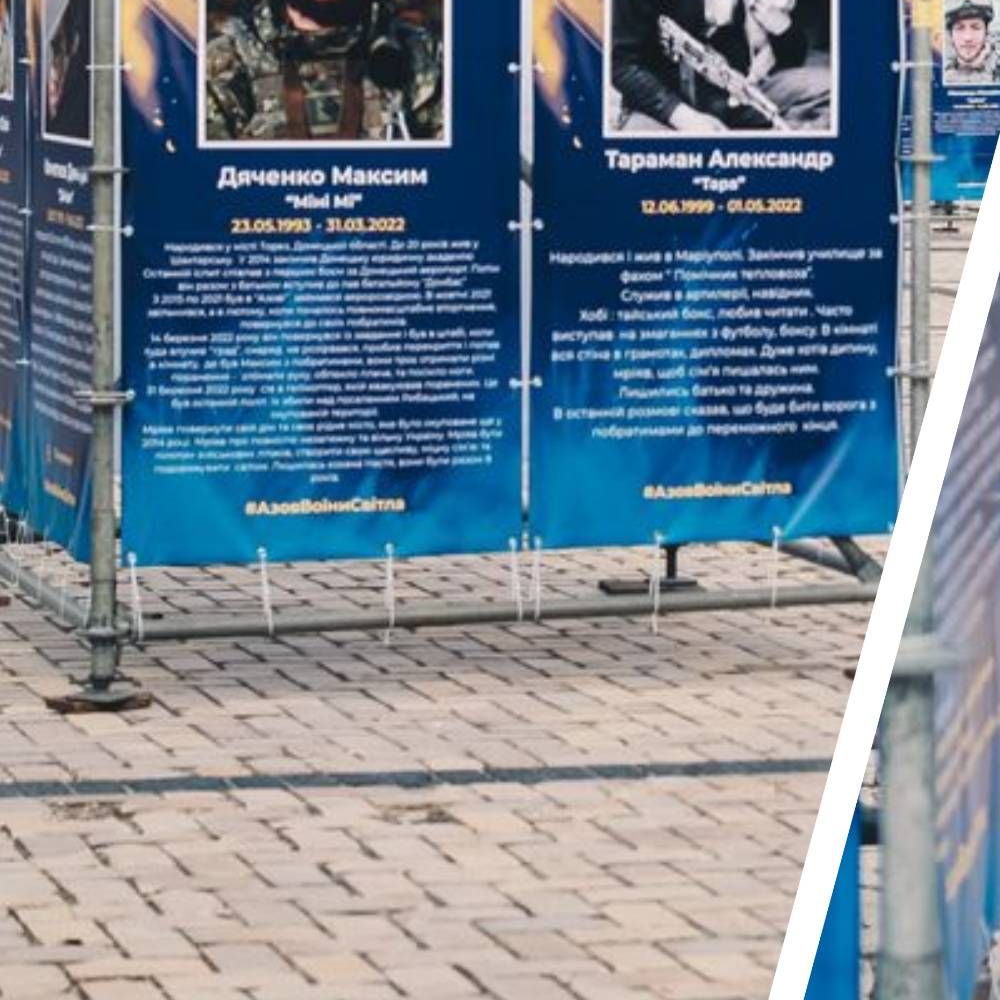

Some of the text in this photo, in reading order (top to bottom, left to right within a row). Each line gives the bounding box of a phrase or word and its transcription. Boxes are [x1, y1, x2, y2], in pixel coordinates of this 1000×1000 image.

[604, 149, 834, 173] Тараман Александр
[216, 165, 428, 190] Дяченко Максим
[641, 199, 715, 215] 12.06.1999
[231, 217, 312, 234] 23.05.1993
[325, 217, 406, 232] 31.03.2022
[549, 251, 625, 265] Народився
